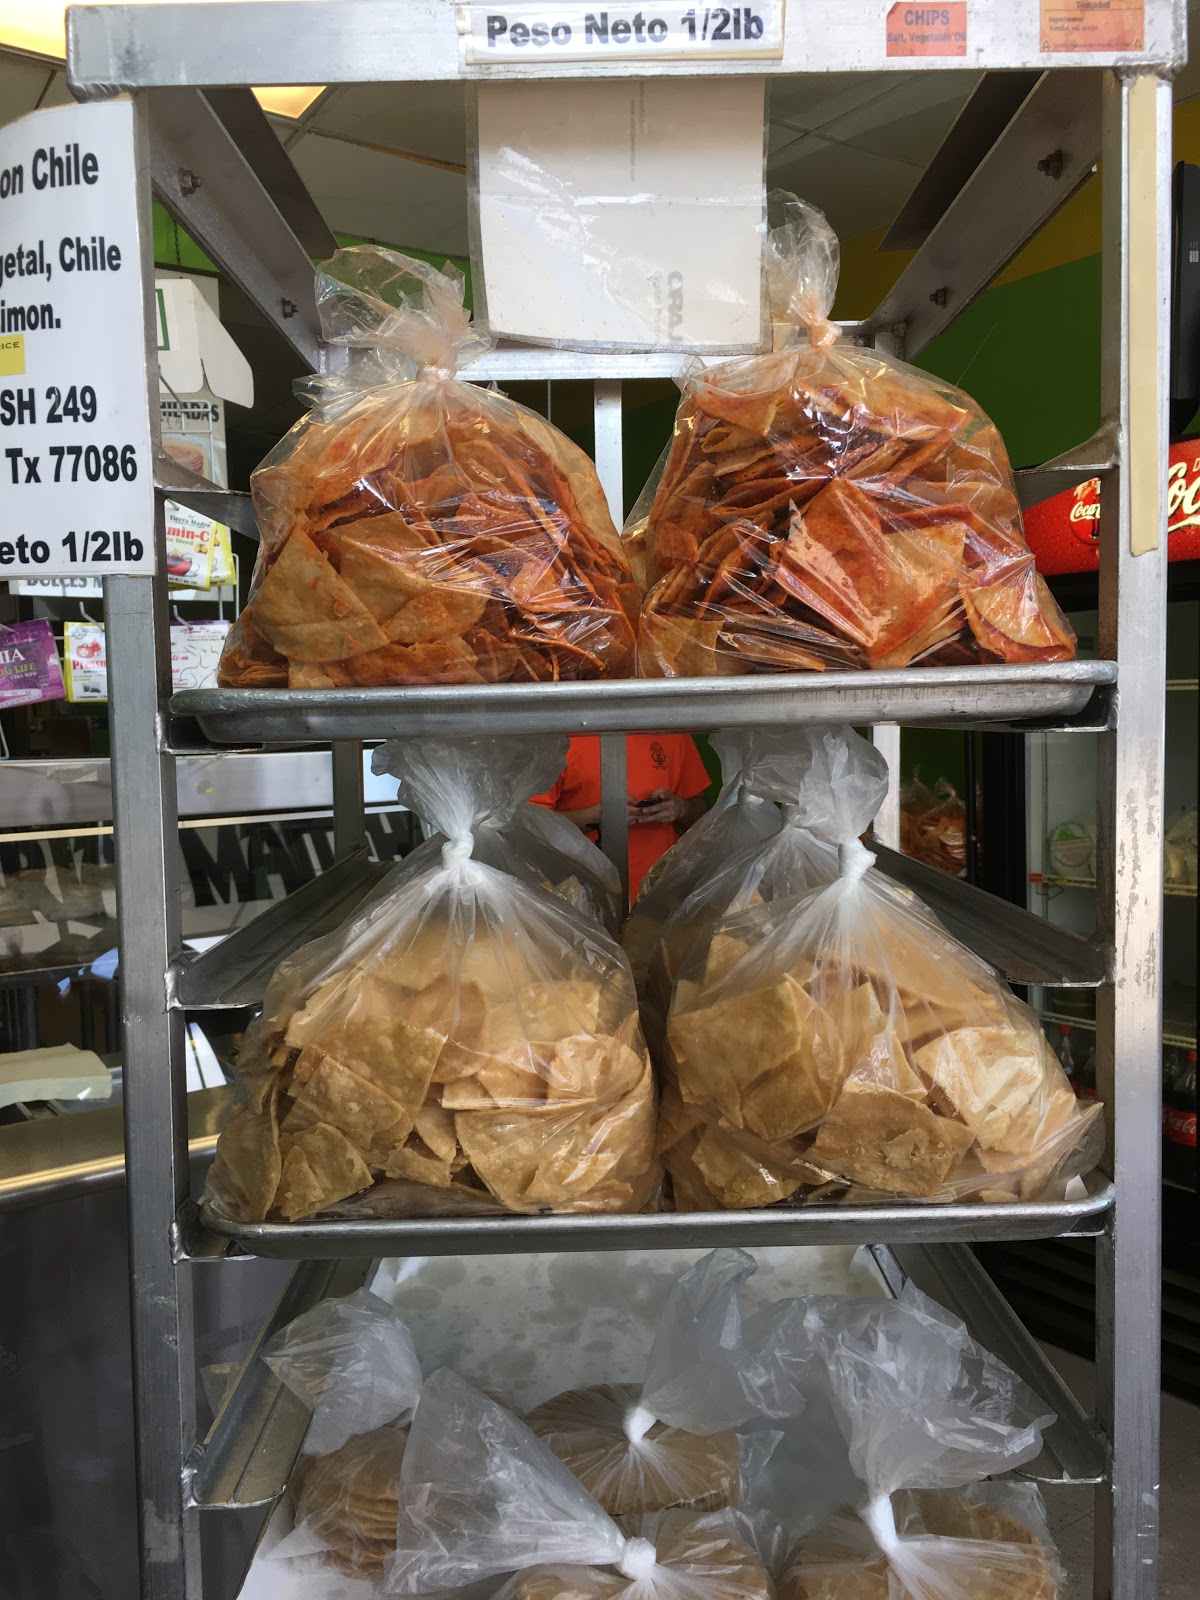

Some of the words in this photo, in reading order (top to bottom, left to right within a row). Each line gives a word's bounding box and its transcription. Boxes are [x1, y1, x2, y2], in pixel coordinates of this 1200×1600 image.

[486, 15, 572, 47] Peso
[584, 11, 668, 45] Neto
[681, 8, 764, 41] 1/2lb
[904, 10, 951, 26] CHIPS
[0, 163, 24, 199] on
[32, 143, 99, 190] Chile
[59, 236, 122, 272] Chile
[0, 300, 62, 333] imon.
[0, 387, 37, 426] SH
[45, 385, 97, 424] 249
[6, 447, 42, 484] Tx
[49, 444, 138, 483] 77086
[0, 533, 51, 565] eto
[62, 531, 144, 563] 1/2lb
